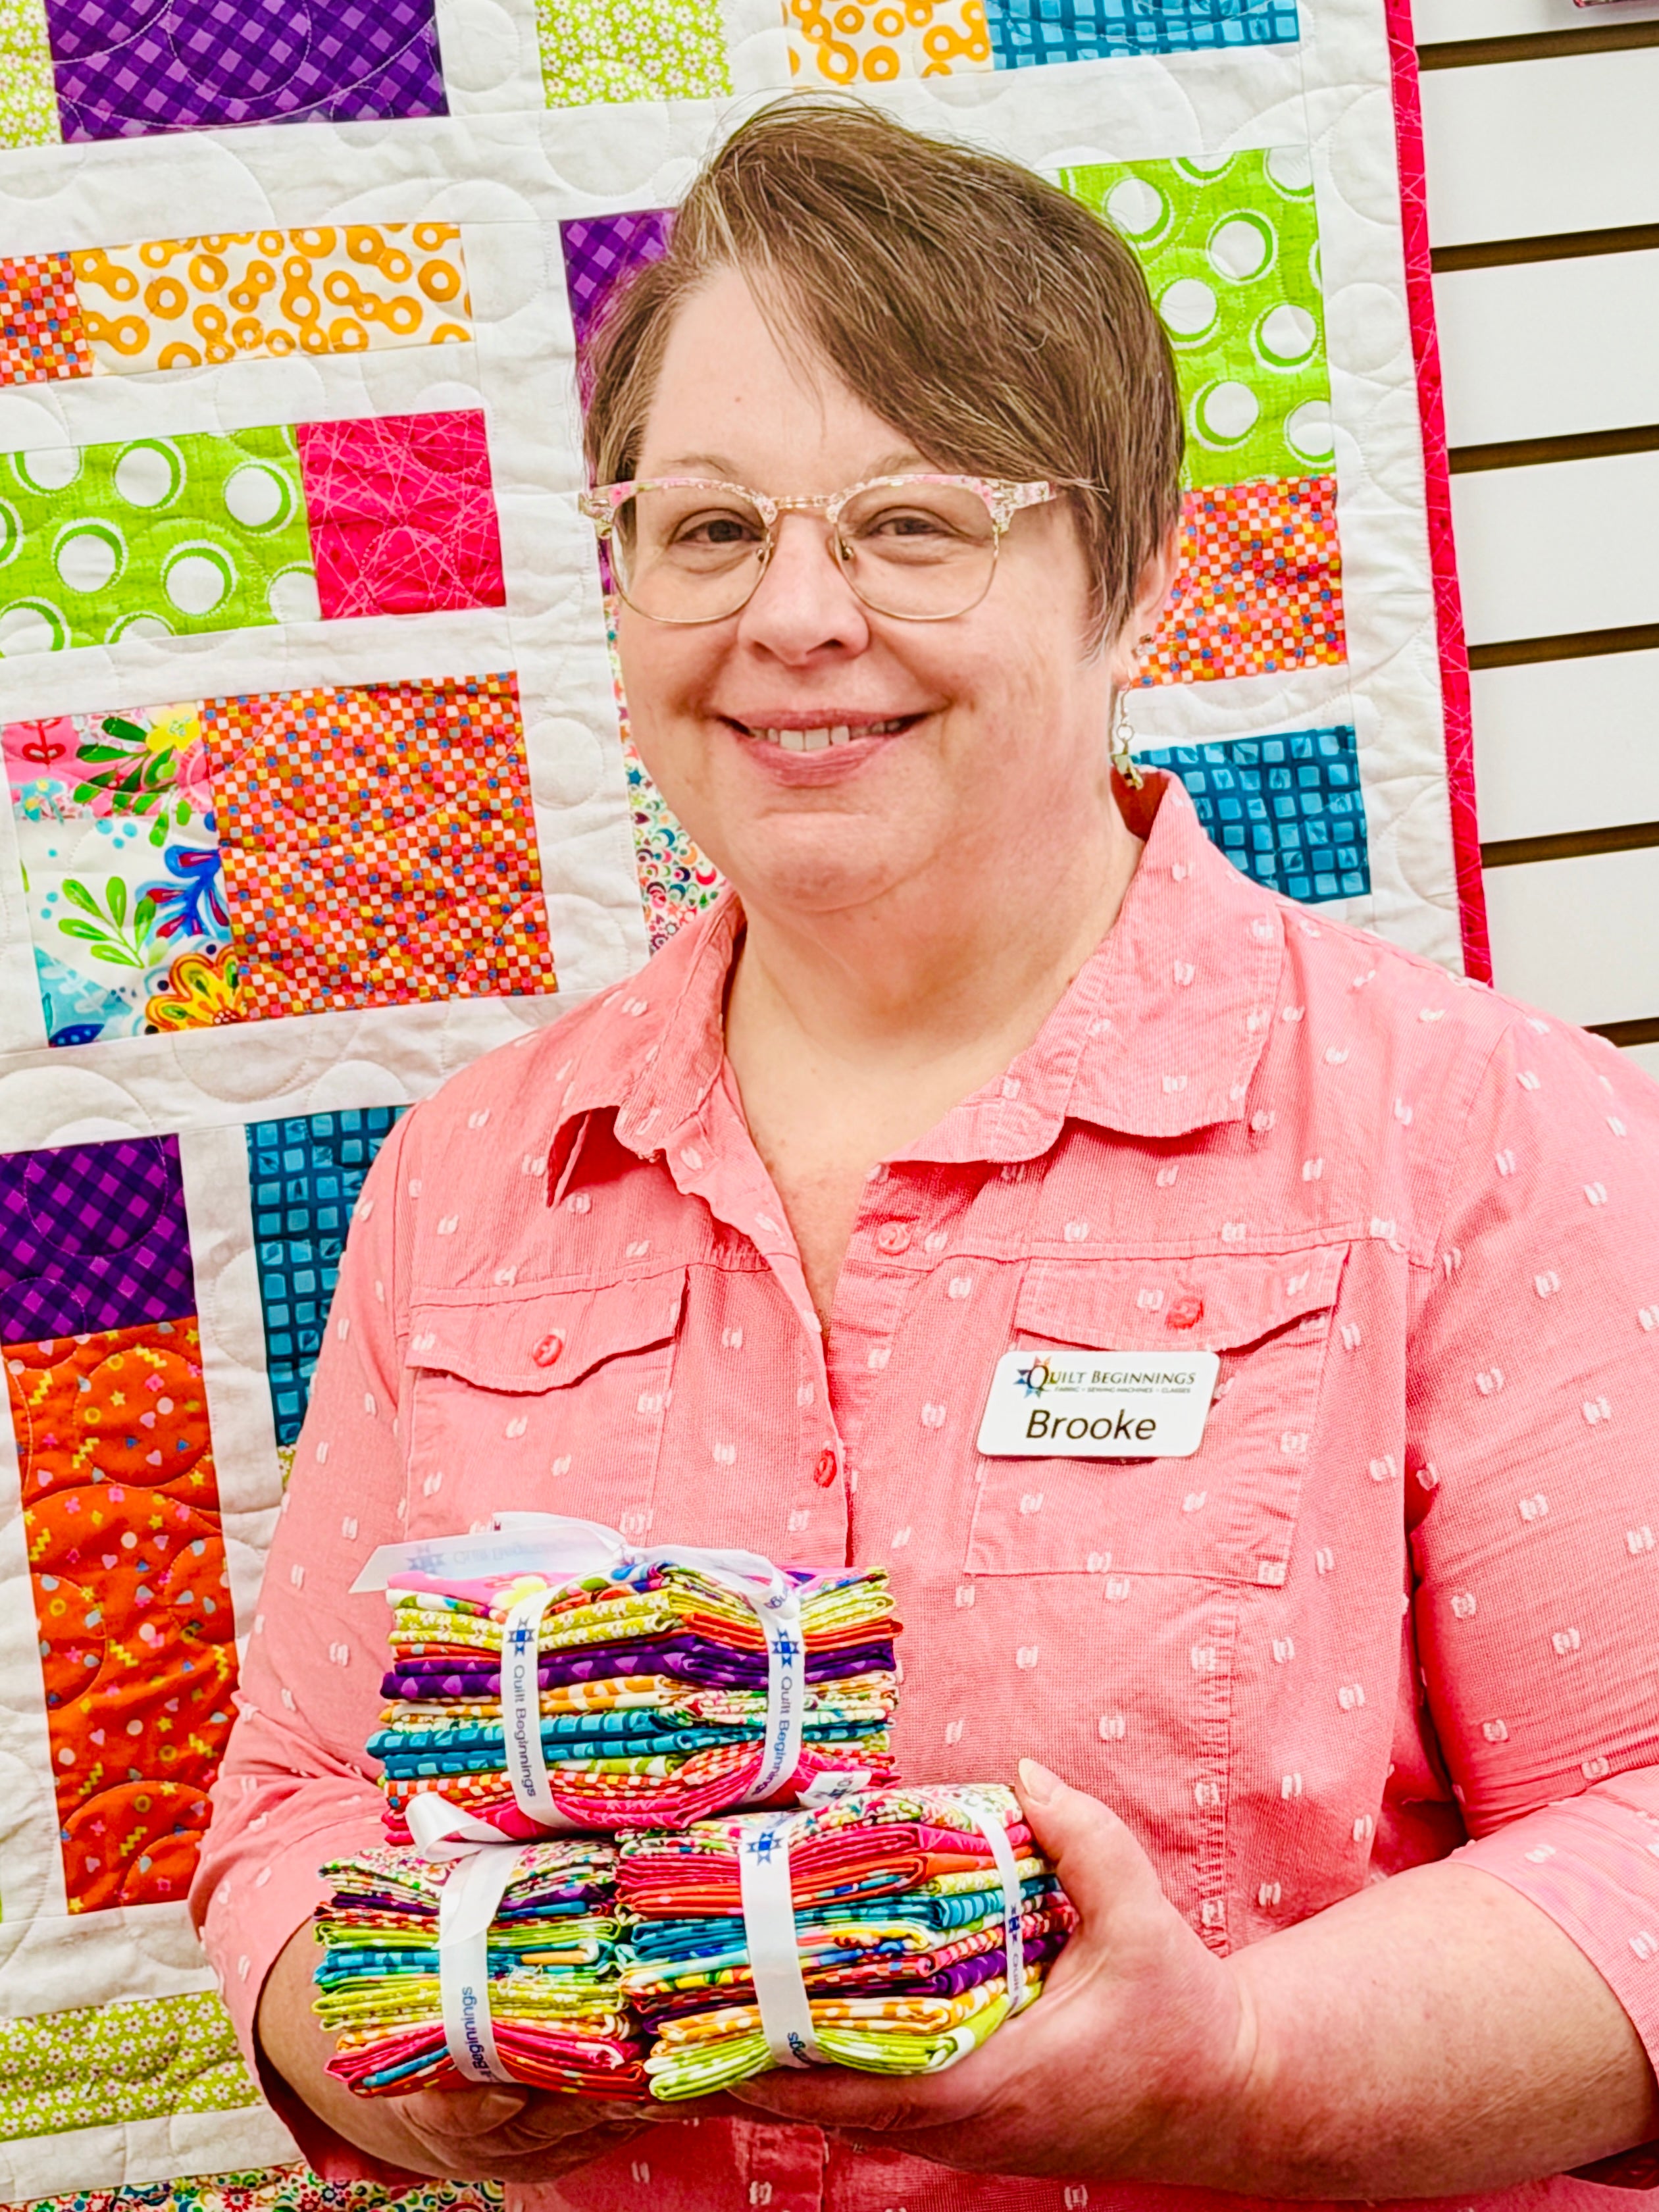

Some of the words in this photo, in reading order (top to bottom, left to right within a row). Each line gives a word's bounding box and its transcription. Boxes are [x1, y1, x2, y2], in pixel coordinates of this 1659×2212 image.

[1026, 1408, 1156, 1440] Brooke
[513, 1664, 526, 1703] Quilt
[779, 1676, 793, 1714] Quilt
[514, 1708, 536, 1797] Beginnings
[460, 1986, 489, 2069] Beginnings
